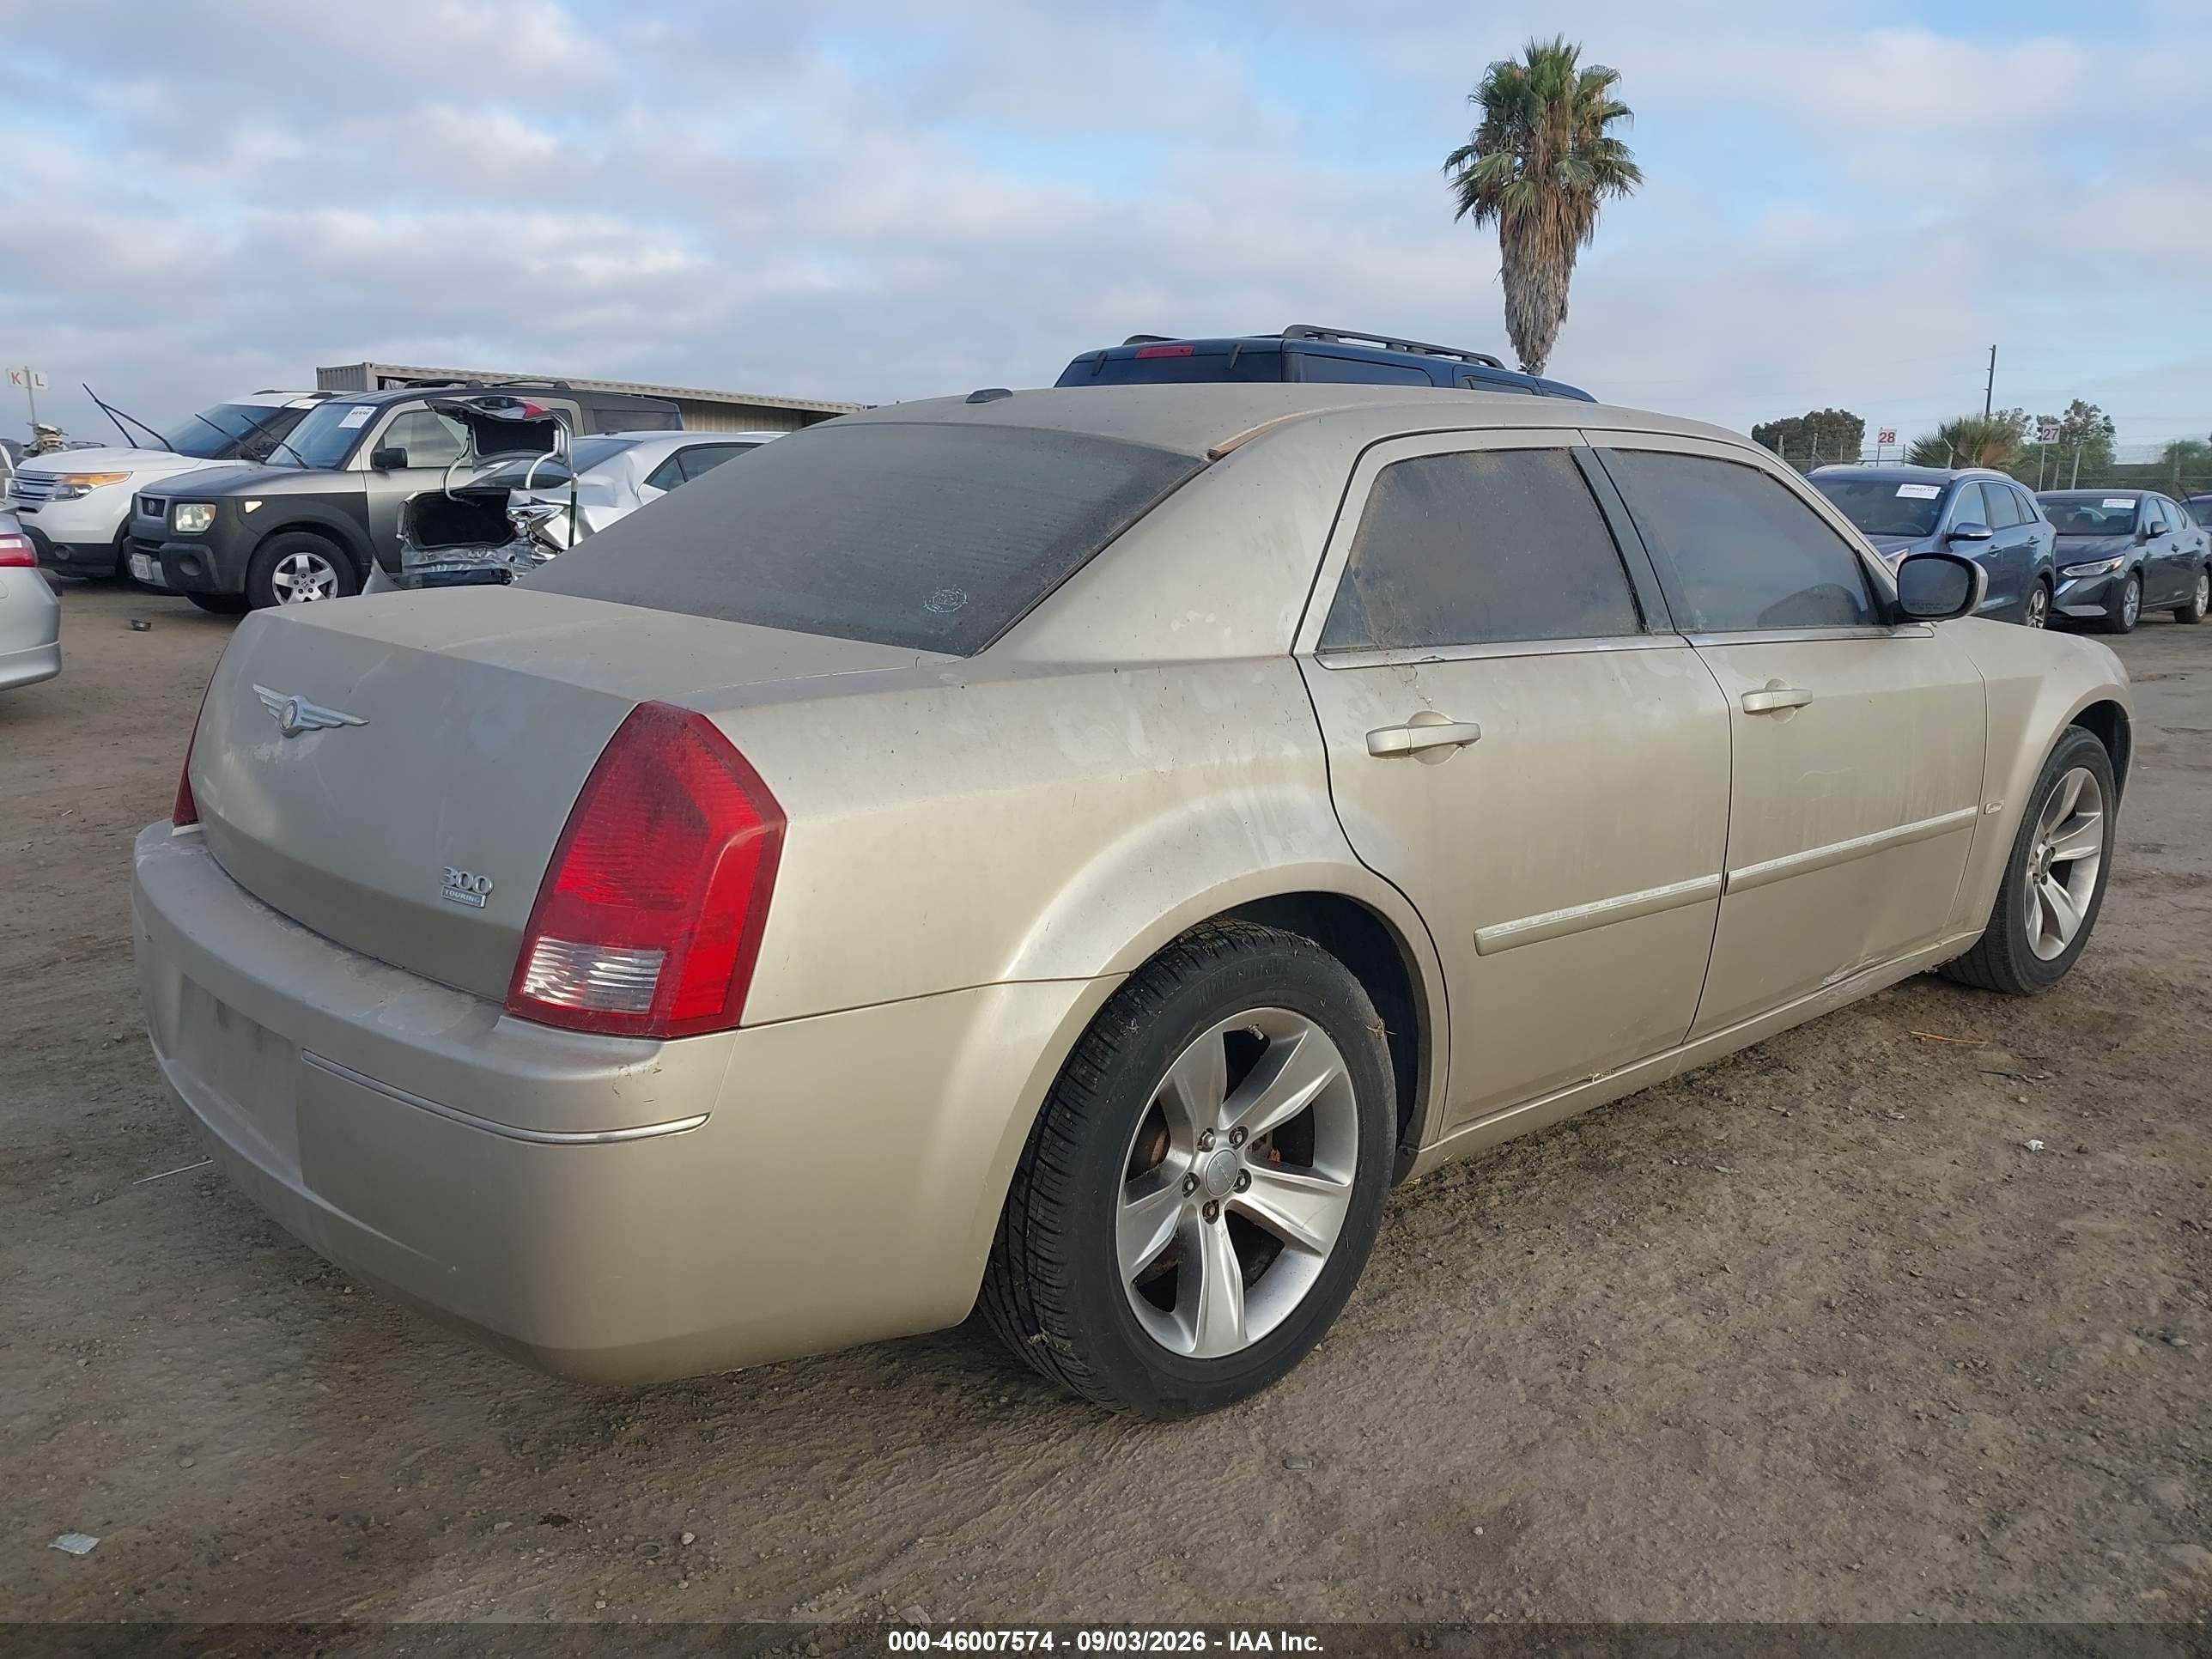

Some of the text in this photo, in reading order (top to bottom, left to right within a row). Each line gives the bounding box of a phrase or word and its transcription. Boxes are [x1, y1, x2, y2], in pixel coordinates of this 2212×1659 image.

[11, 372, 21, 385] K
[35, 374, 45, 386] L
[1878, 432, 1895, 443] 28
[2043, 428, 2059, 441] 27
[439, 866, 494, 895] 300
[443, 889, 481, 904] TOURING
